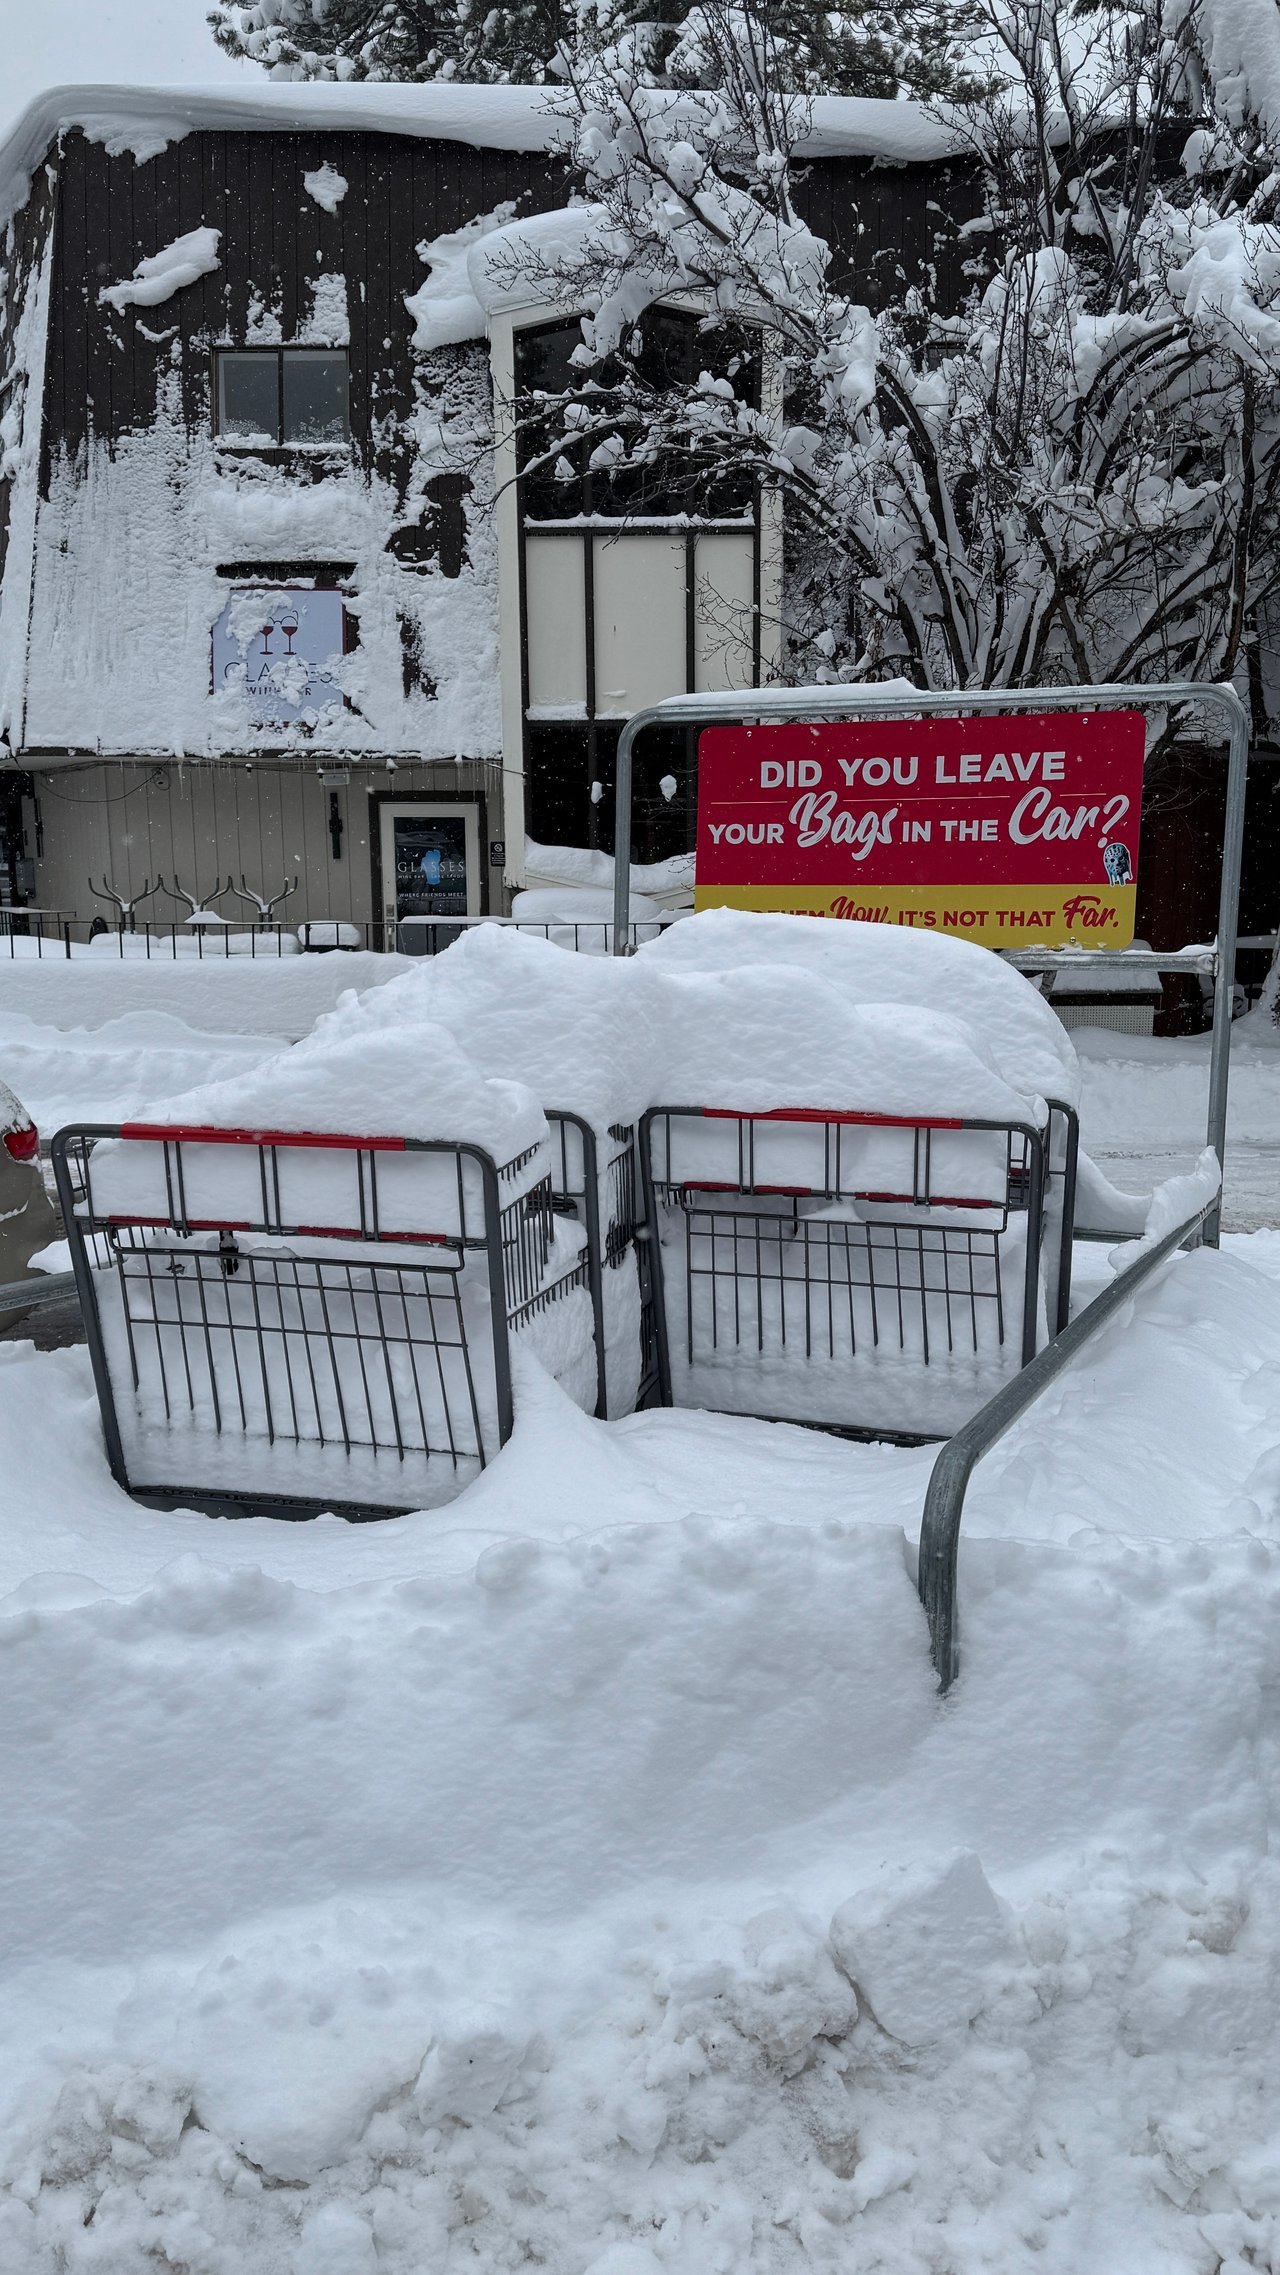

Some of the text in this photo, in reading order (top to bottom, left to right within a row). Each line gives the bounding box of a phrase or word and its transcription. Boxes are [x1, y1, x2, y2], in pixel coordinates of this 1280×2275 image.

[224, 662, 333, 684] GLAES
[760, 750, 1066, 789] DID YOU LEAVE
[708, 786, 1131, 861] YOUR Bags IN THE Car?
[397, 861, 464, 873] GLASSES
[898, 910, 937, 927] IT'S
[943, 910, 989, 927] NOT
[995, 910, 1056, 928] THAT
[1062, 895, 1120, 930] Far.
